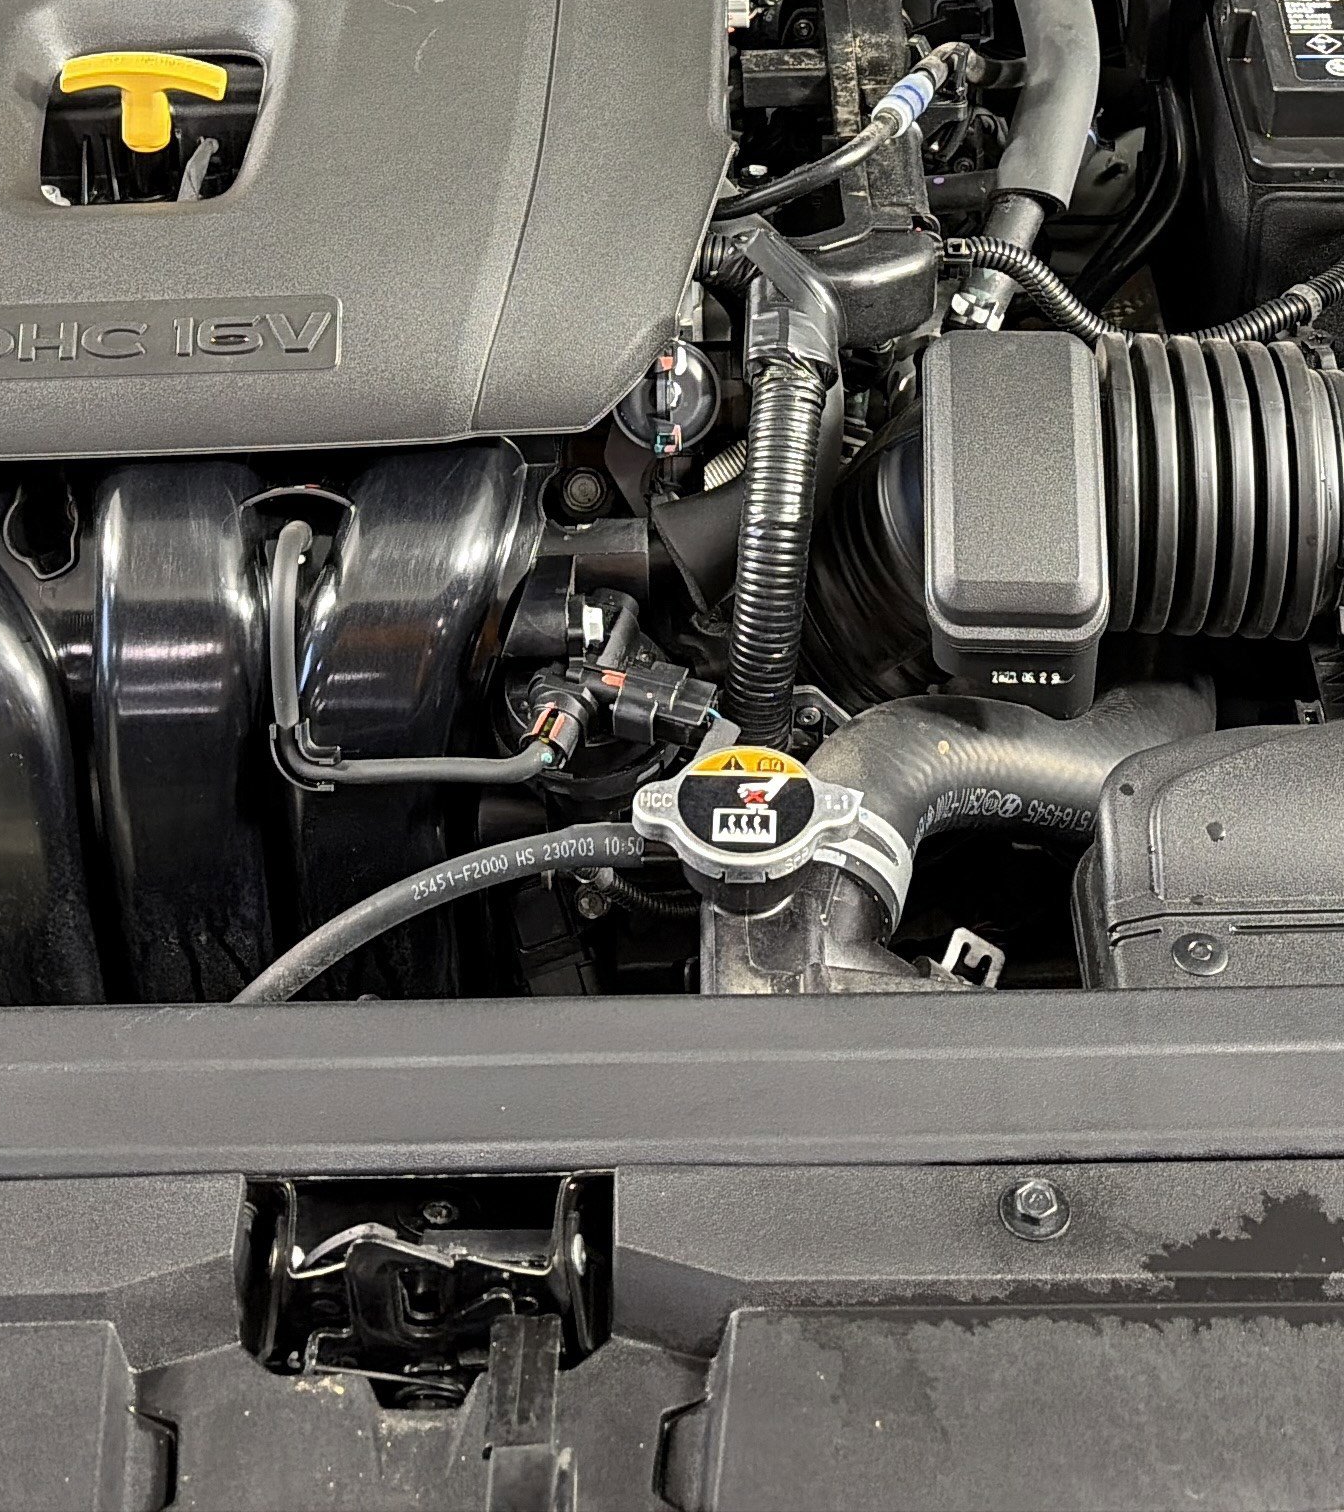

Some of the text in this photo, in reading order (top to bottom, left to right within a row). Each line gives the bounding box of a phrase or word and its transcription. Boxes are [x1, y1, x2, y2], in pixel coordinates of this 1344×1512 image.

[173, 312, 332, 358] 16V
[639, 792, 674, 808] HCC
[824, 794, 850, 810] 1.1
[410, 836, 645, 901] 25451-F2000 HS 230703 10:50
